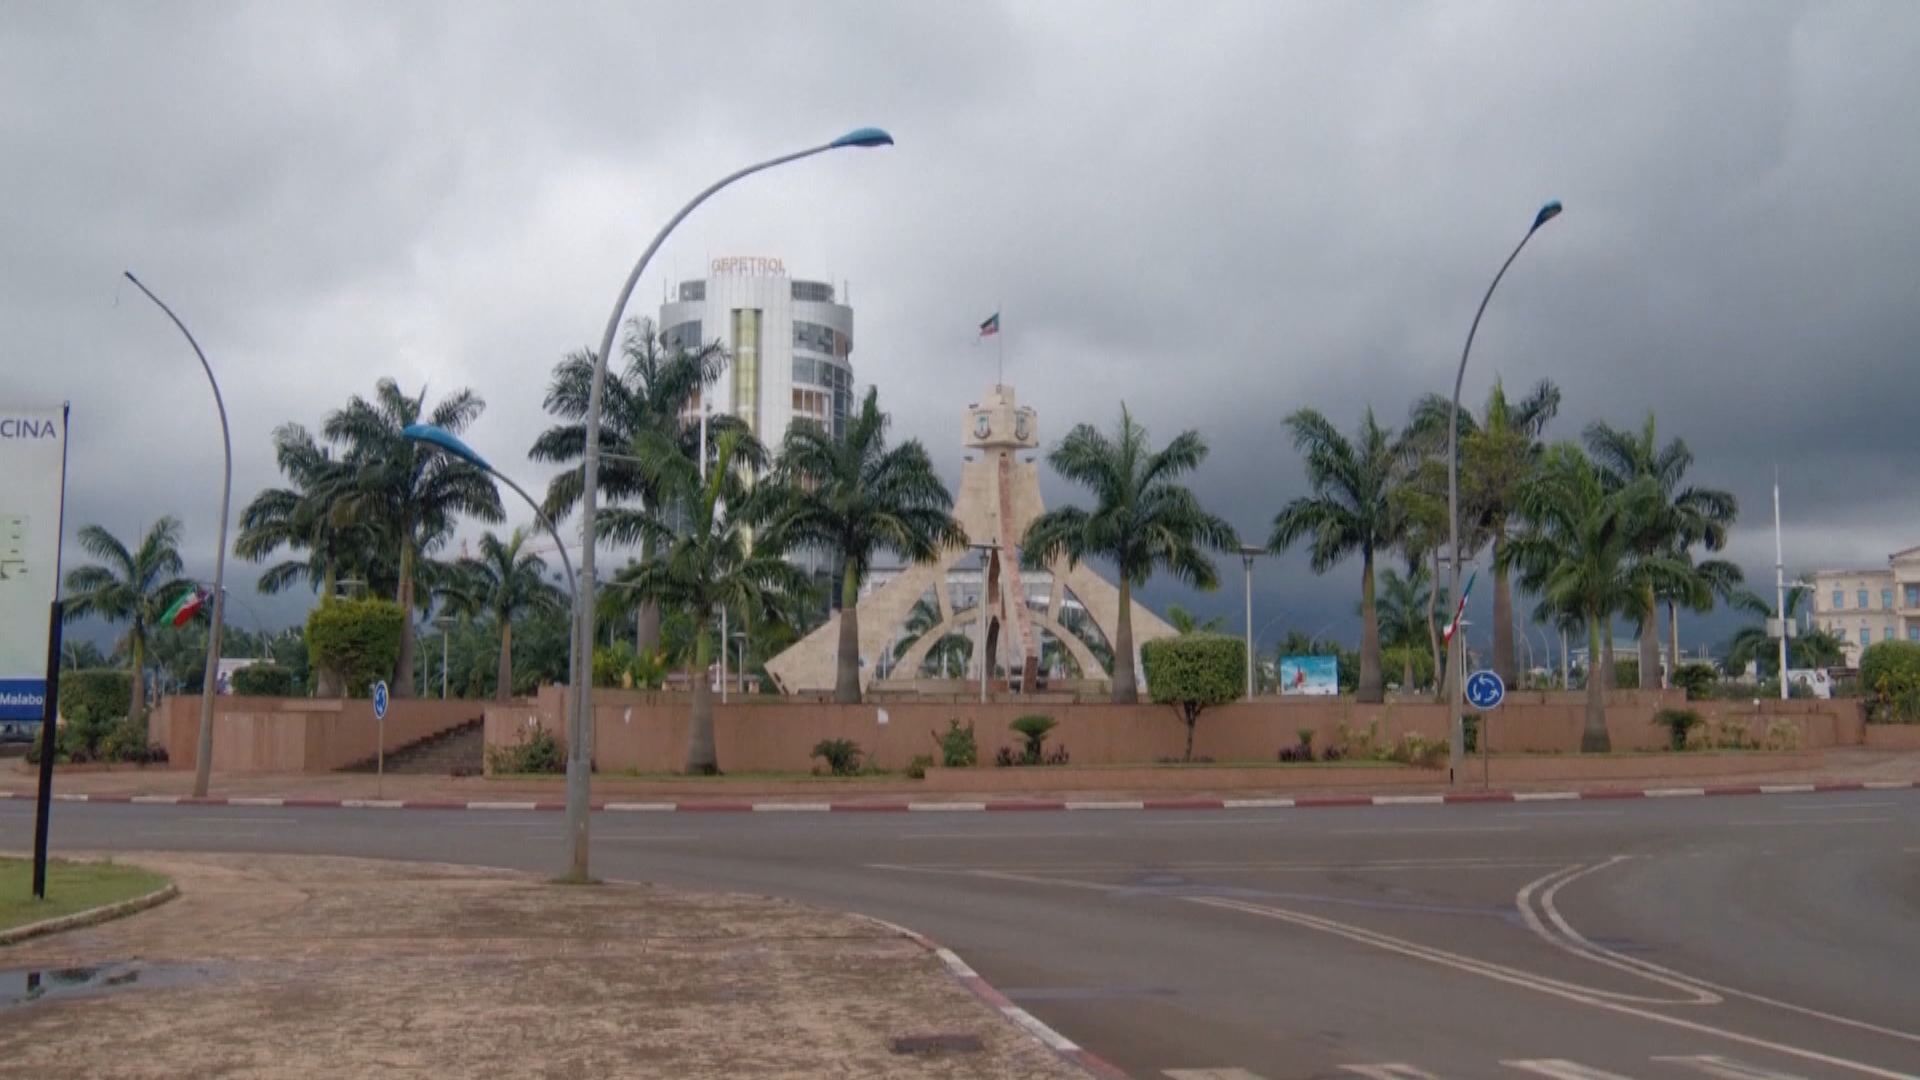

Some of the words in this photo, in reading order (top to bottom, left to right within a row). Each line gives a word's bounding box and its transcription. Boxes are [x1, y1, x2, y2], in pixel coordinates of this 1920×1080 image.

[711, 256, 785, 275] GEPETROL
[0, 419, 56, 438] CINA
[0, 692, 43, 705] Malabo
